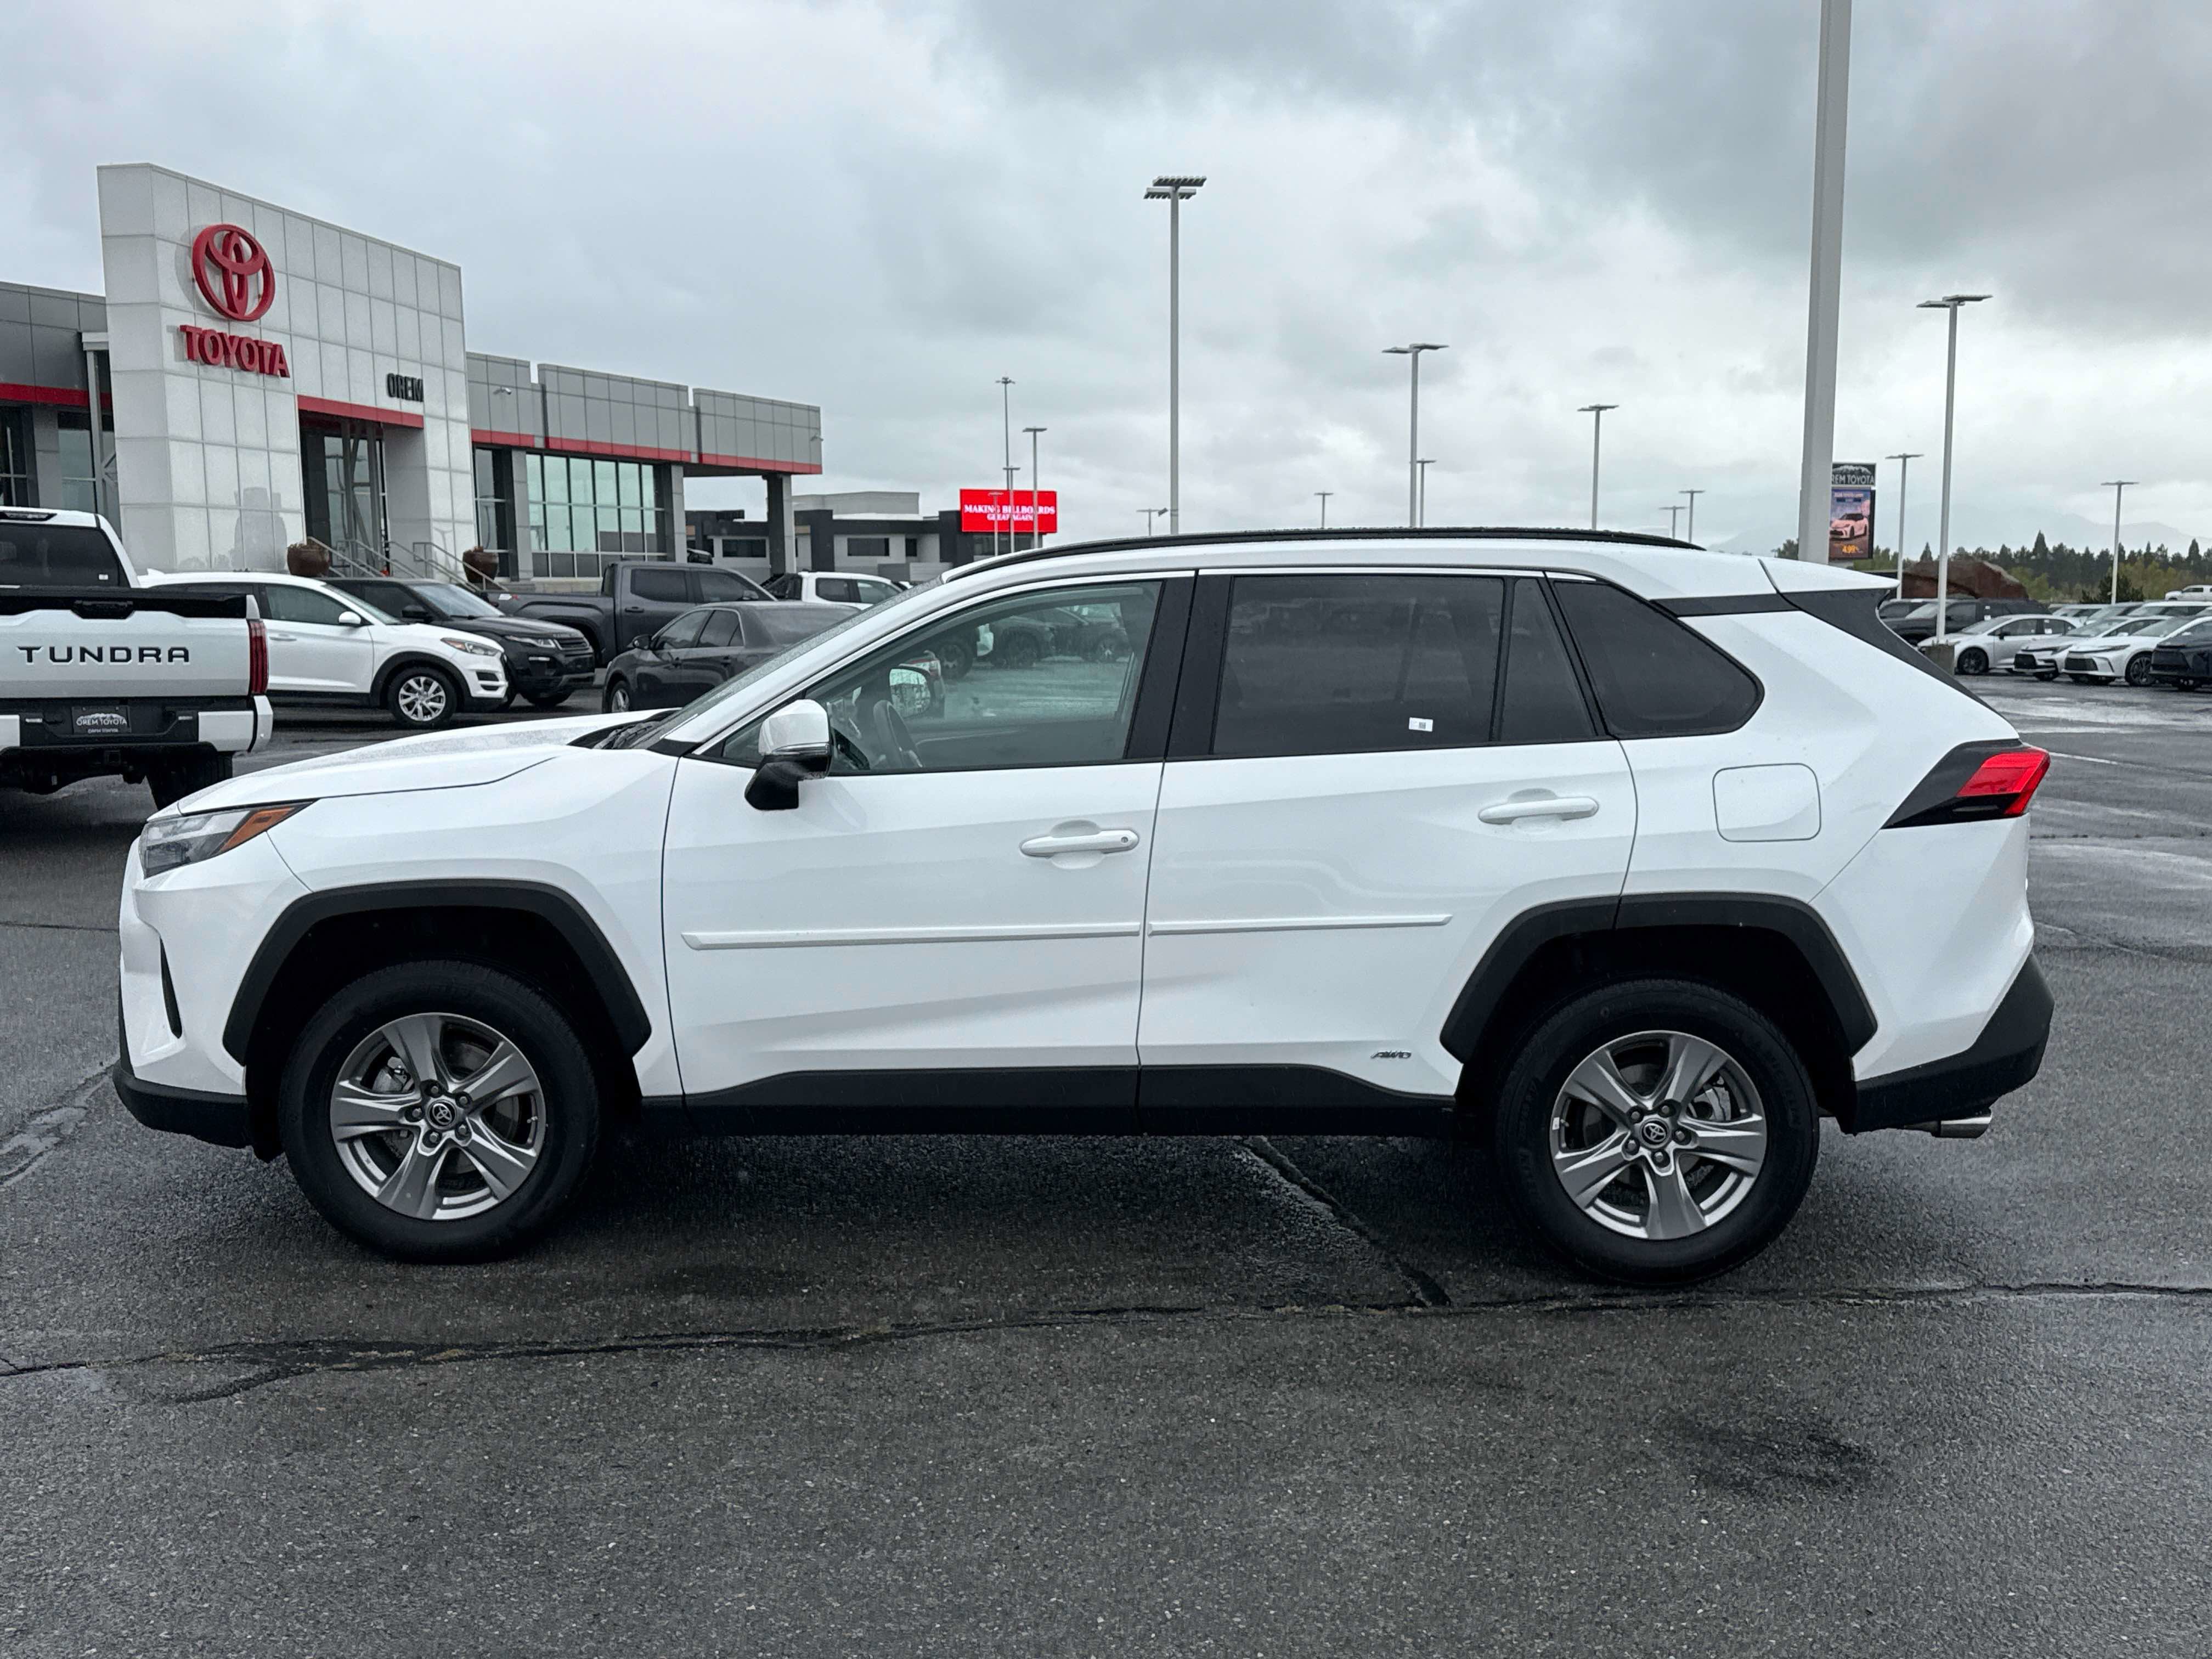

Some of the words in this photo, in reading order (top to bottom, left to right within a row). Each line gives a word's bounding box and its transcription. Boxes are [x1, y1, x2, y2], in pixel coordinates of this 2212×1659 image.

[179, 324, 290, 379] TOYOTA
[387, 373, 424, 402] OREM
[1831, 474, 1846, 484] REM
[1847, 474, 1874, 484] TOYOTA
[1002, 505, 1056, 515] BILBORDS
[17, 646, 190, 663] TUNDRA
